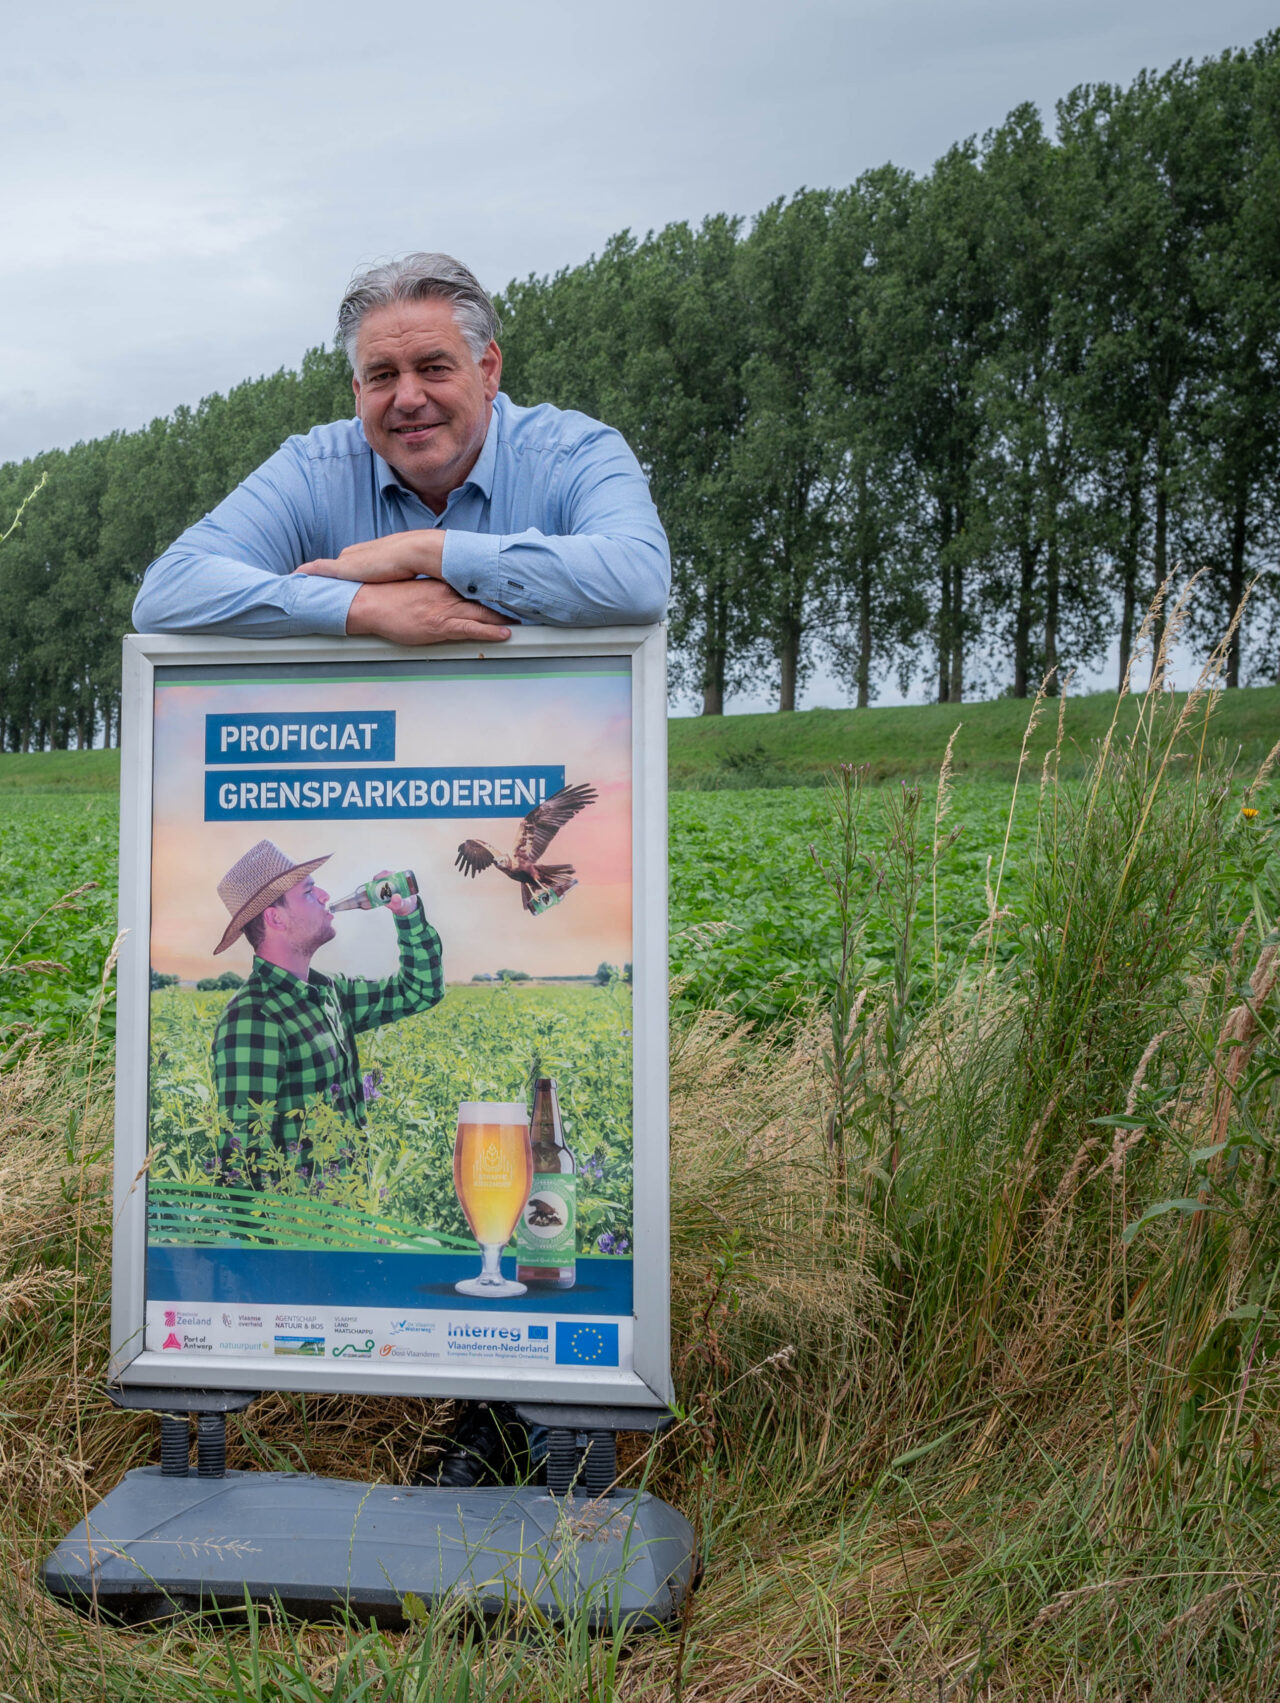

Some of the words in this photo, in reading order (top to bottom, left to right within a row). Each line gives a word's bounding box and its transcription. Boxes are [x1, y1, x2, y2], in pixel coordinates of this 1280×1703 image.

[220, 723, 378, 752] PROFICIAT
[218, 778, 547, 809] GRENSPARKBOEREN!
[177, 1317, 212, 1326] Zeeland
[448, 1322, 521, 1342] Interreg
[183, 1335, 198, 1343] Port
[183, 1342, 213, 1351] Antwerp
[220, 1341, 262, 1350] natuurpunt
[448, 1341, 549, 1353] Vlaanderen-Nederland
